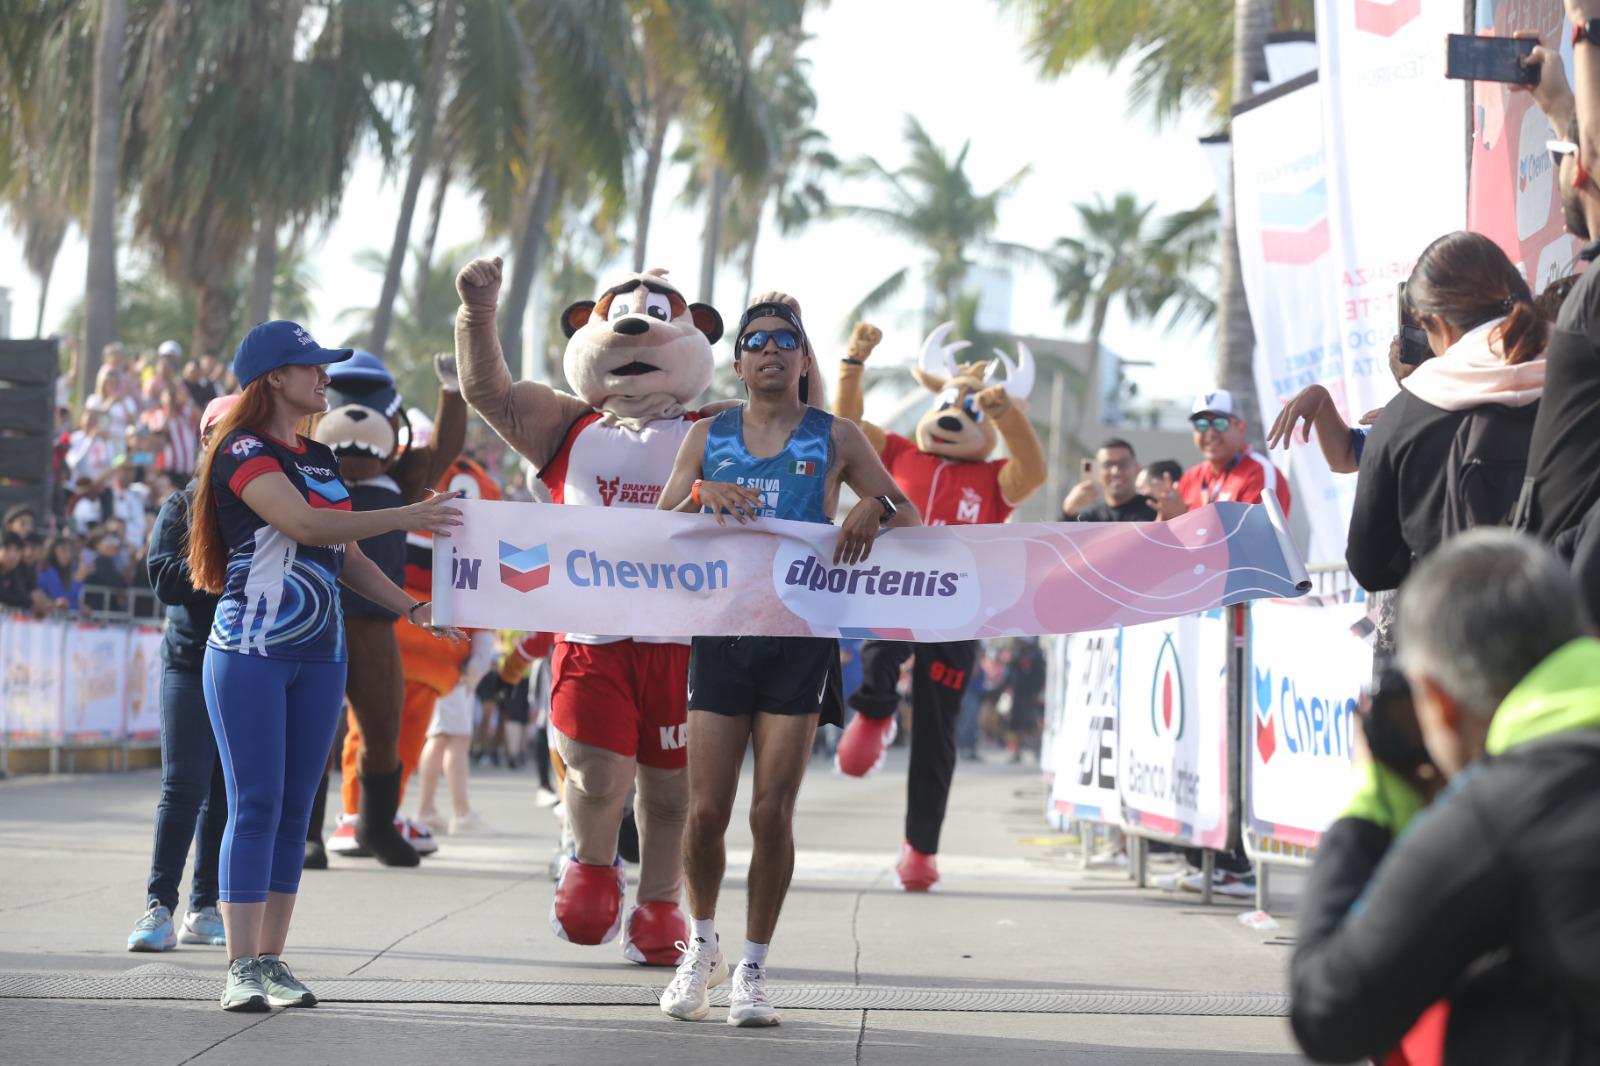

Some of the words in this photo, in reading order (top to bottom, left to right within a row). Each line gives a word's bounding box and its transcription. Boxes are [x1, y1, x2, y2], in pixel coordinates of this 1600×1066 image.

[566, 549, 728, 593] Chevron
[784, 555, 959, 597] dportenis
[1281, 676, 1357, 760] Chevro
